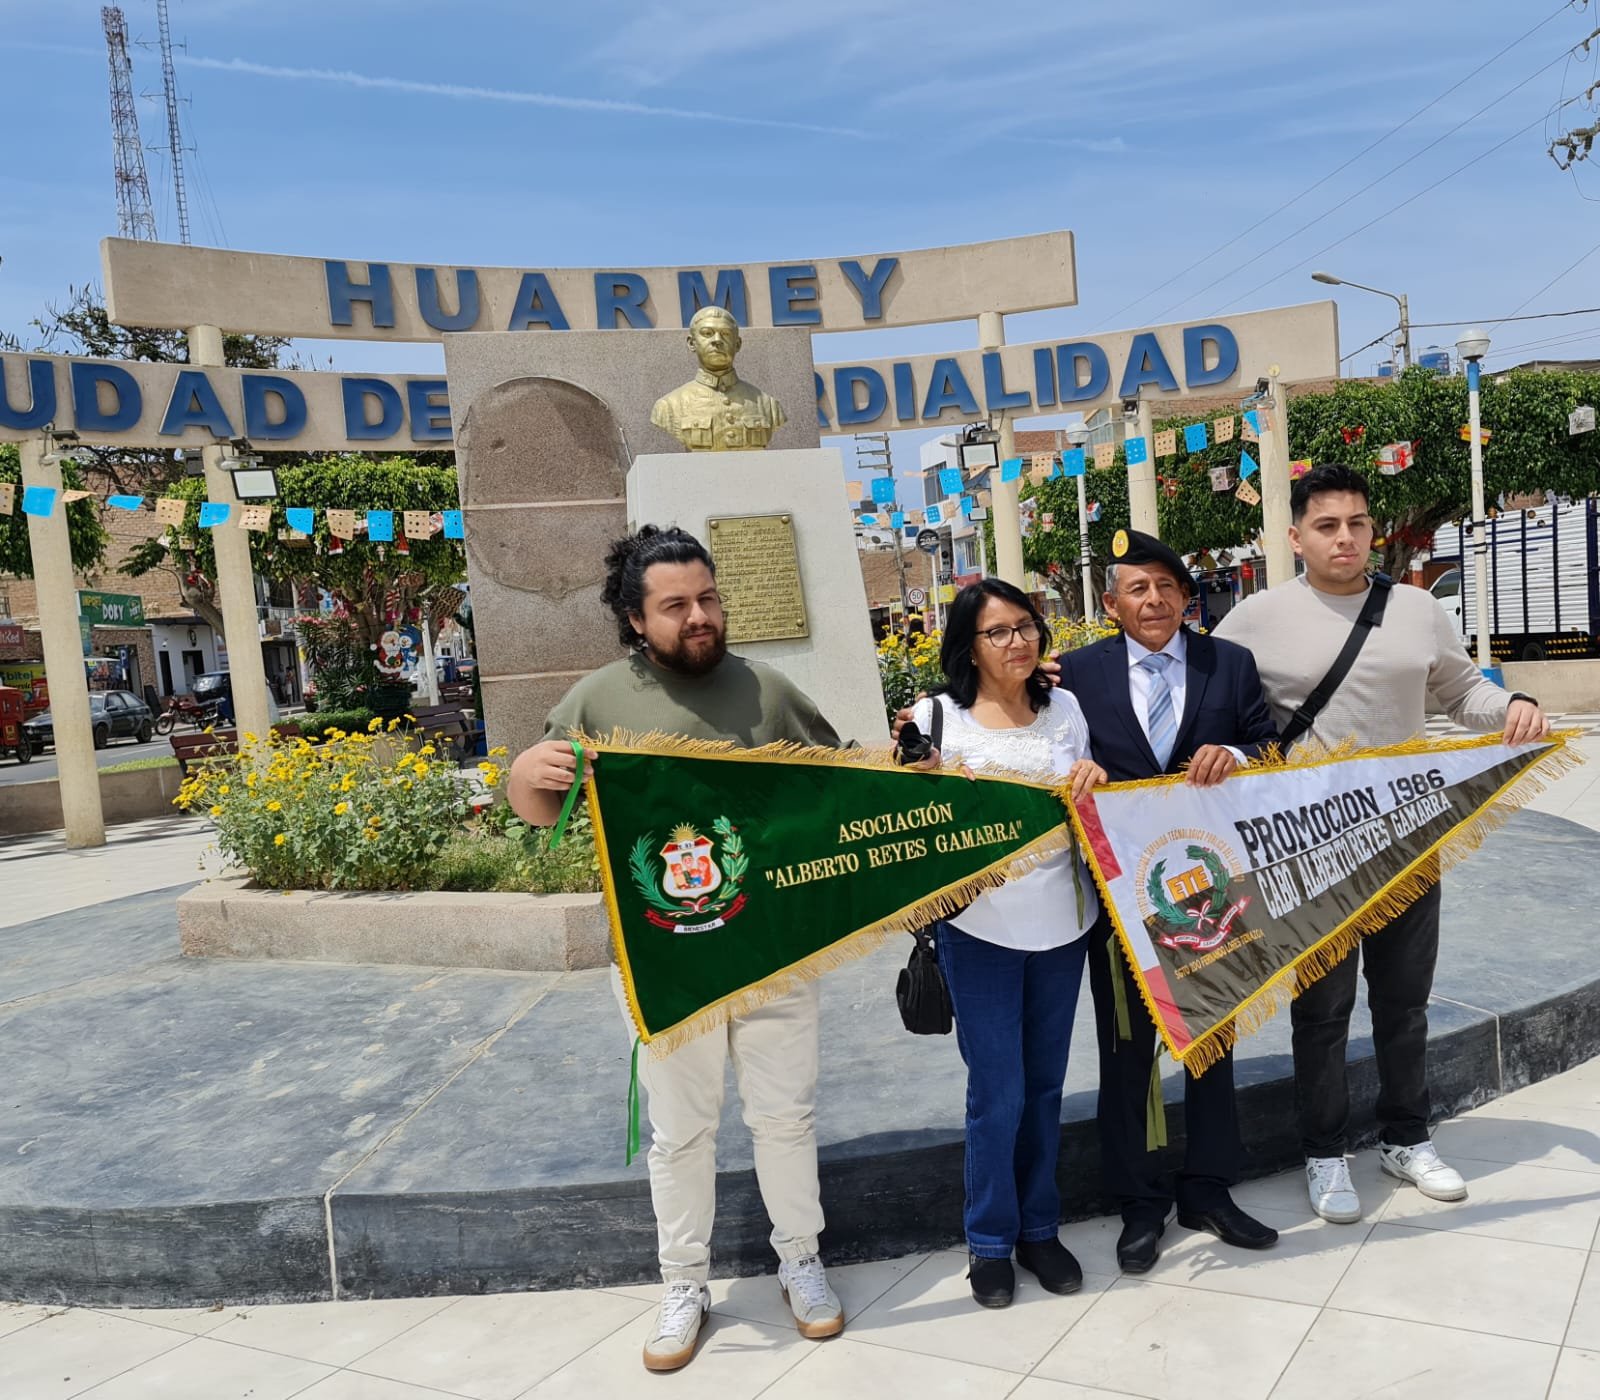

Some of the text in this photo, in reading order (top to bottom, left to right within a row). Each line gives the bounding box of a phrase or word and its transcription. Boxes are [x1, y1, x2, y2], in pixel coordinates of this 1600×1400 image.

[325, 256, 899, 331] HUARMEY
[342, 377, 454, 442] DE
[102, 603, 124, 621] DOKY
[838, 801, 954, 844] ASOCIACIÓN
[1234, 768, 1446, 870] PROMOCION 1986
[765, 819, 1023, 889] "ALBERTO REYES GAMARRA"
[1166, 865, 1211, 903] ETE
[1255, 857, 1302, 920] CABO
[1296, 833, 1360, 901] ALBERTO
[1347, 818, 1393, 866] REYES
[1390, 790, 1452, 839] GAMARRA
